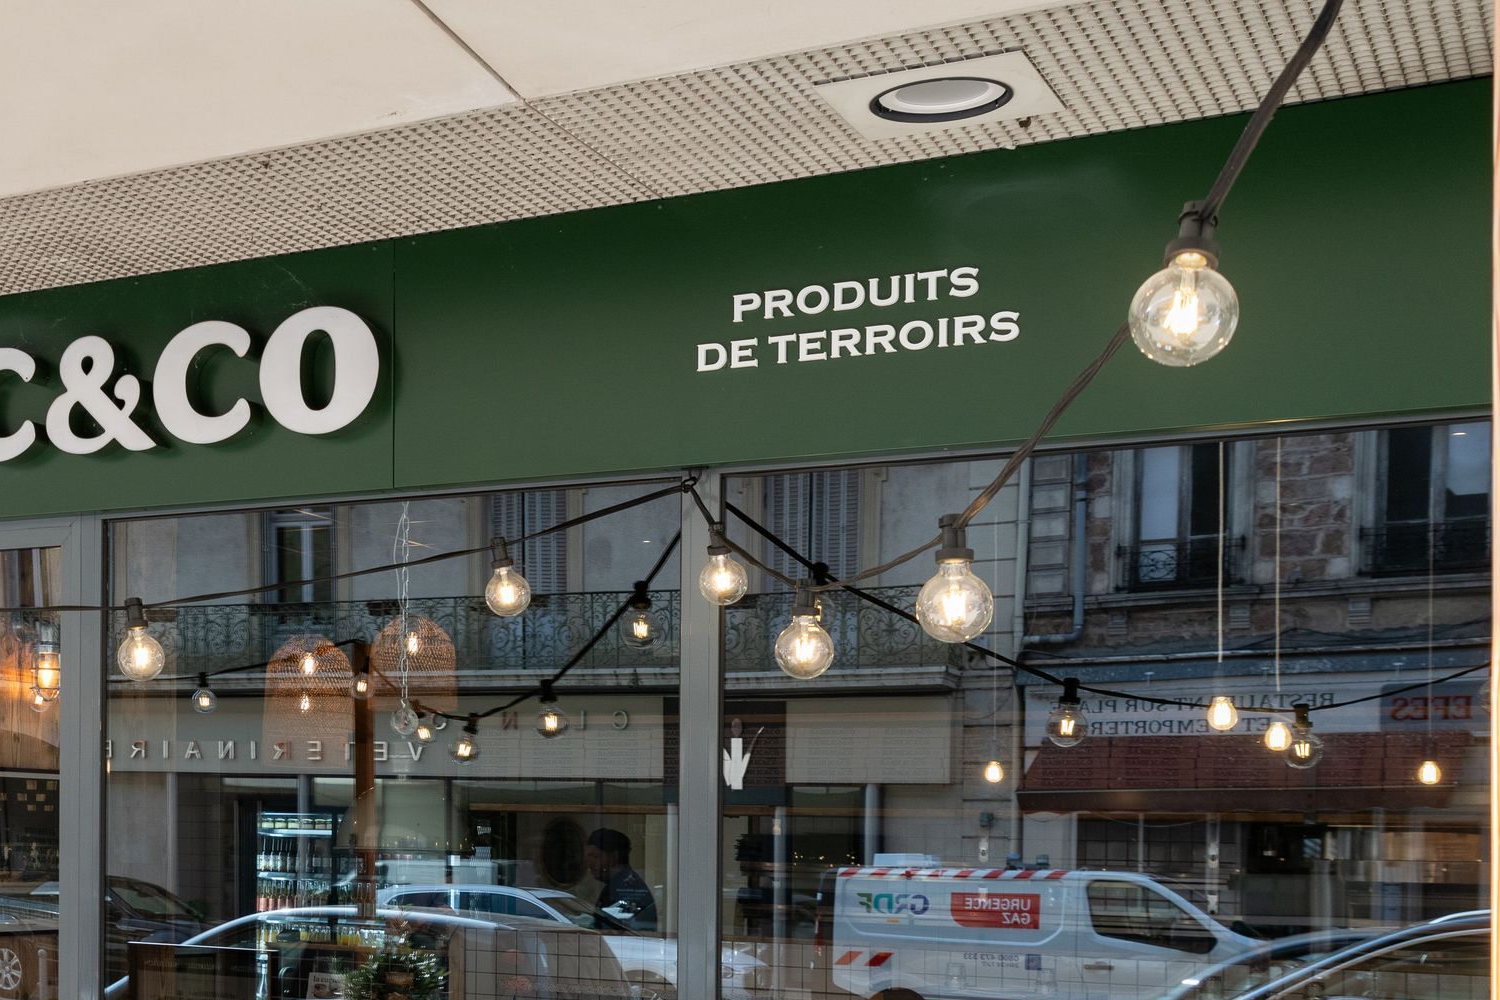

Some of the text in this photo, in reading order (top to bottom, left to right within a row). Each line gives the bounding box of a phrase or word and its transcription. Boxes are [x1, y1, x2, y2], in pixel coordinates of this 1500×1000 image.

[732, 266, 980, 323] PRODUITS
[696, 310, 1021, 373] DE TERROIRS
